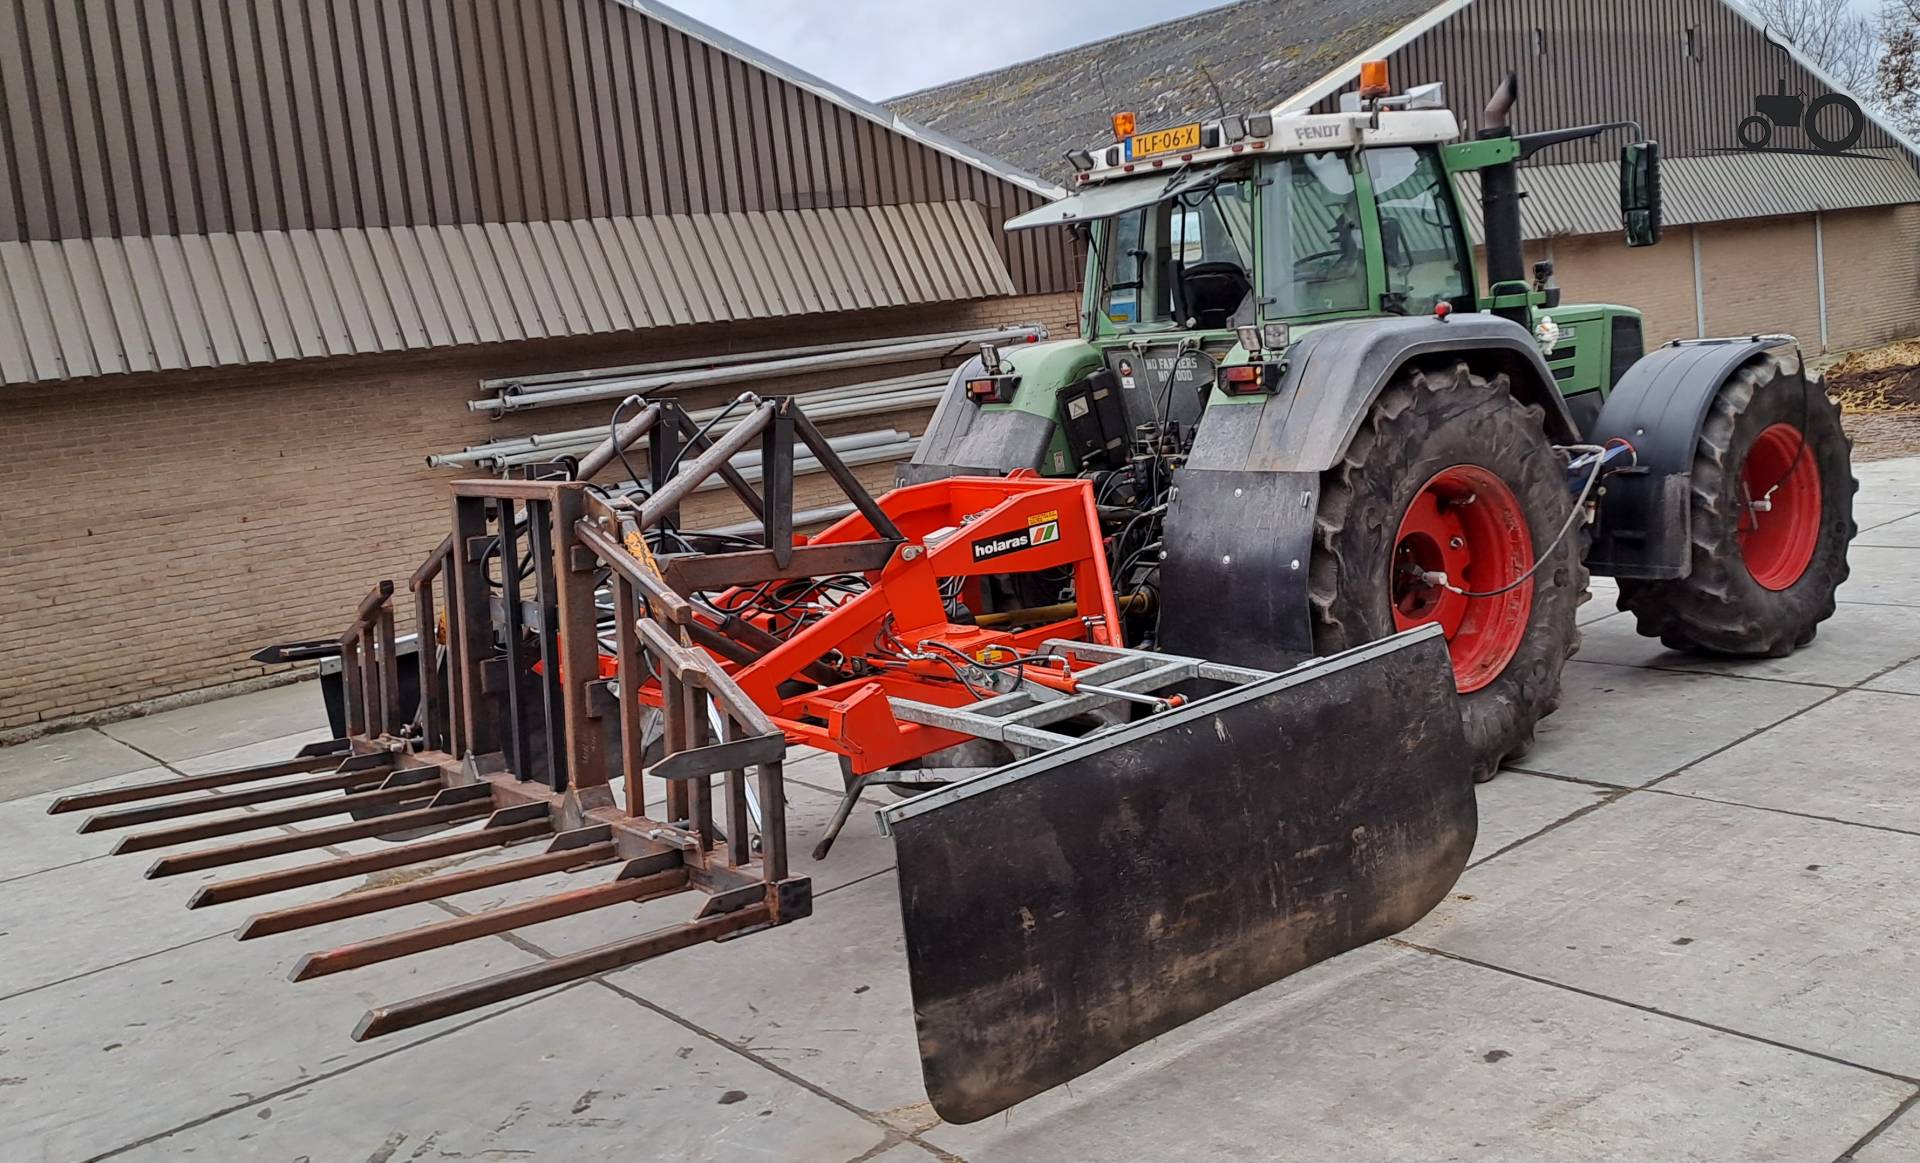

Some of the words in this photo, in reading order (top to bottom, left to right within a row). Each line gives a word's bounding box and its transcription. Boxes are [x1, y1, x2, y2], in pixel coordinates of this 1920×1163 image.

[1294, 124, 1341, 140] FENDT
[1136, 127, 1194, 154] TLF-06-X
[1145, 358, 1158, 370] NO
[1157, 370, 1169, 382] NO
[1172, 369, 1193, 382] OOD
[974, 535, 1029, 557] holaras
